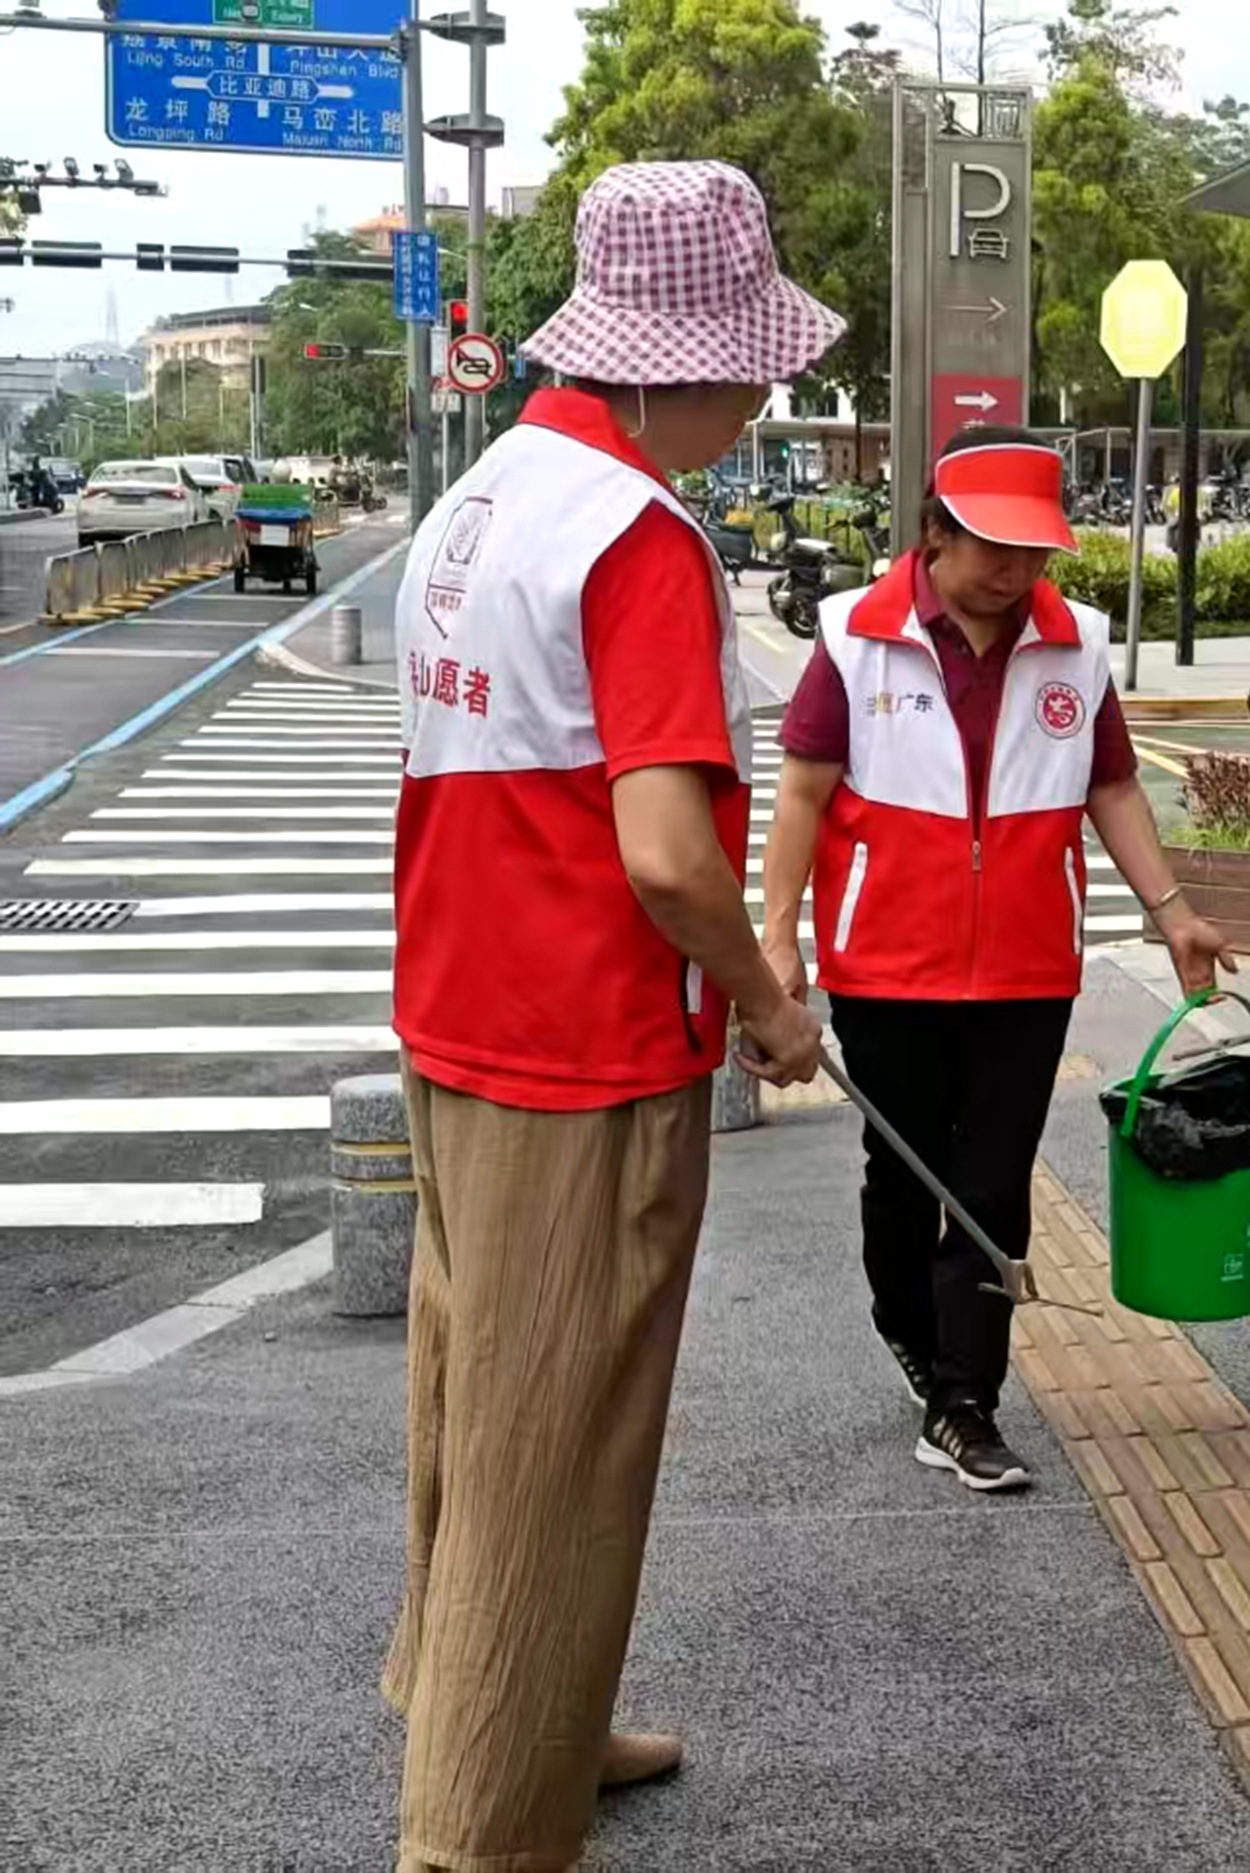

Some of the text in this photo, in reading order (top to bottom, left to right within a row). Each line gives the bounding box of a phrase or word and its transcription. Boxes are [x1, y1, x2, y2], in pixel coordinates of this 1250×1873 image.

[173, 53, 214, 68] South
[225, 56, 246, 69] Rd
[290, 59, 400, 79] Pingshan Blvd
[219, 75, 311, 100] 比亚迪路
[124, 96, 231, 126] 龙坪路
[281, 105, 403, 134] 马峦北路
[128, 121, 225, 142] Longping Rd
[950, 161, 1012, 257] P
